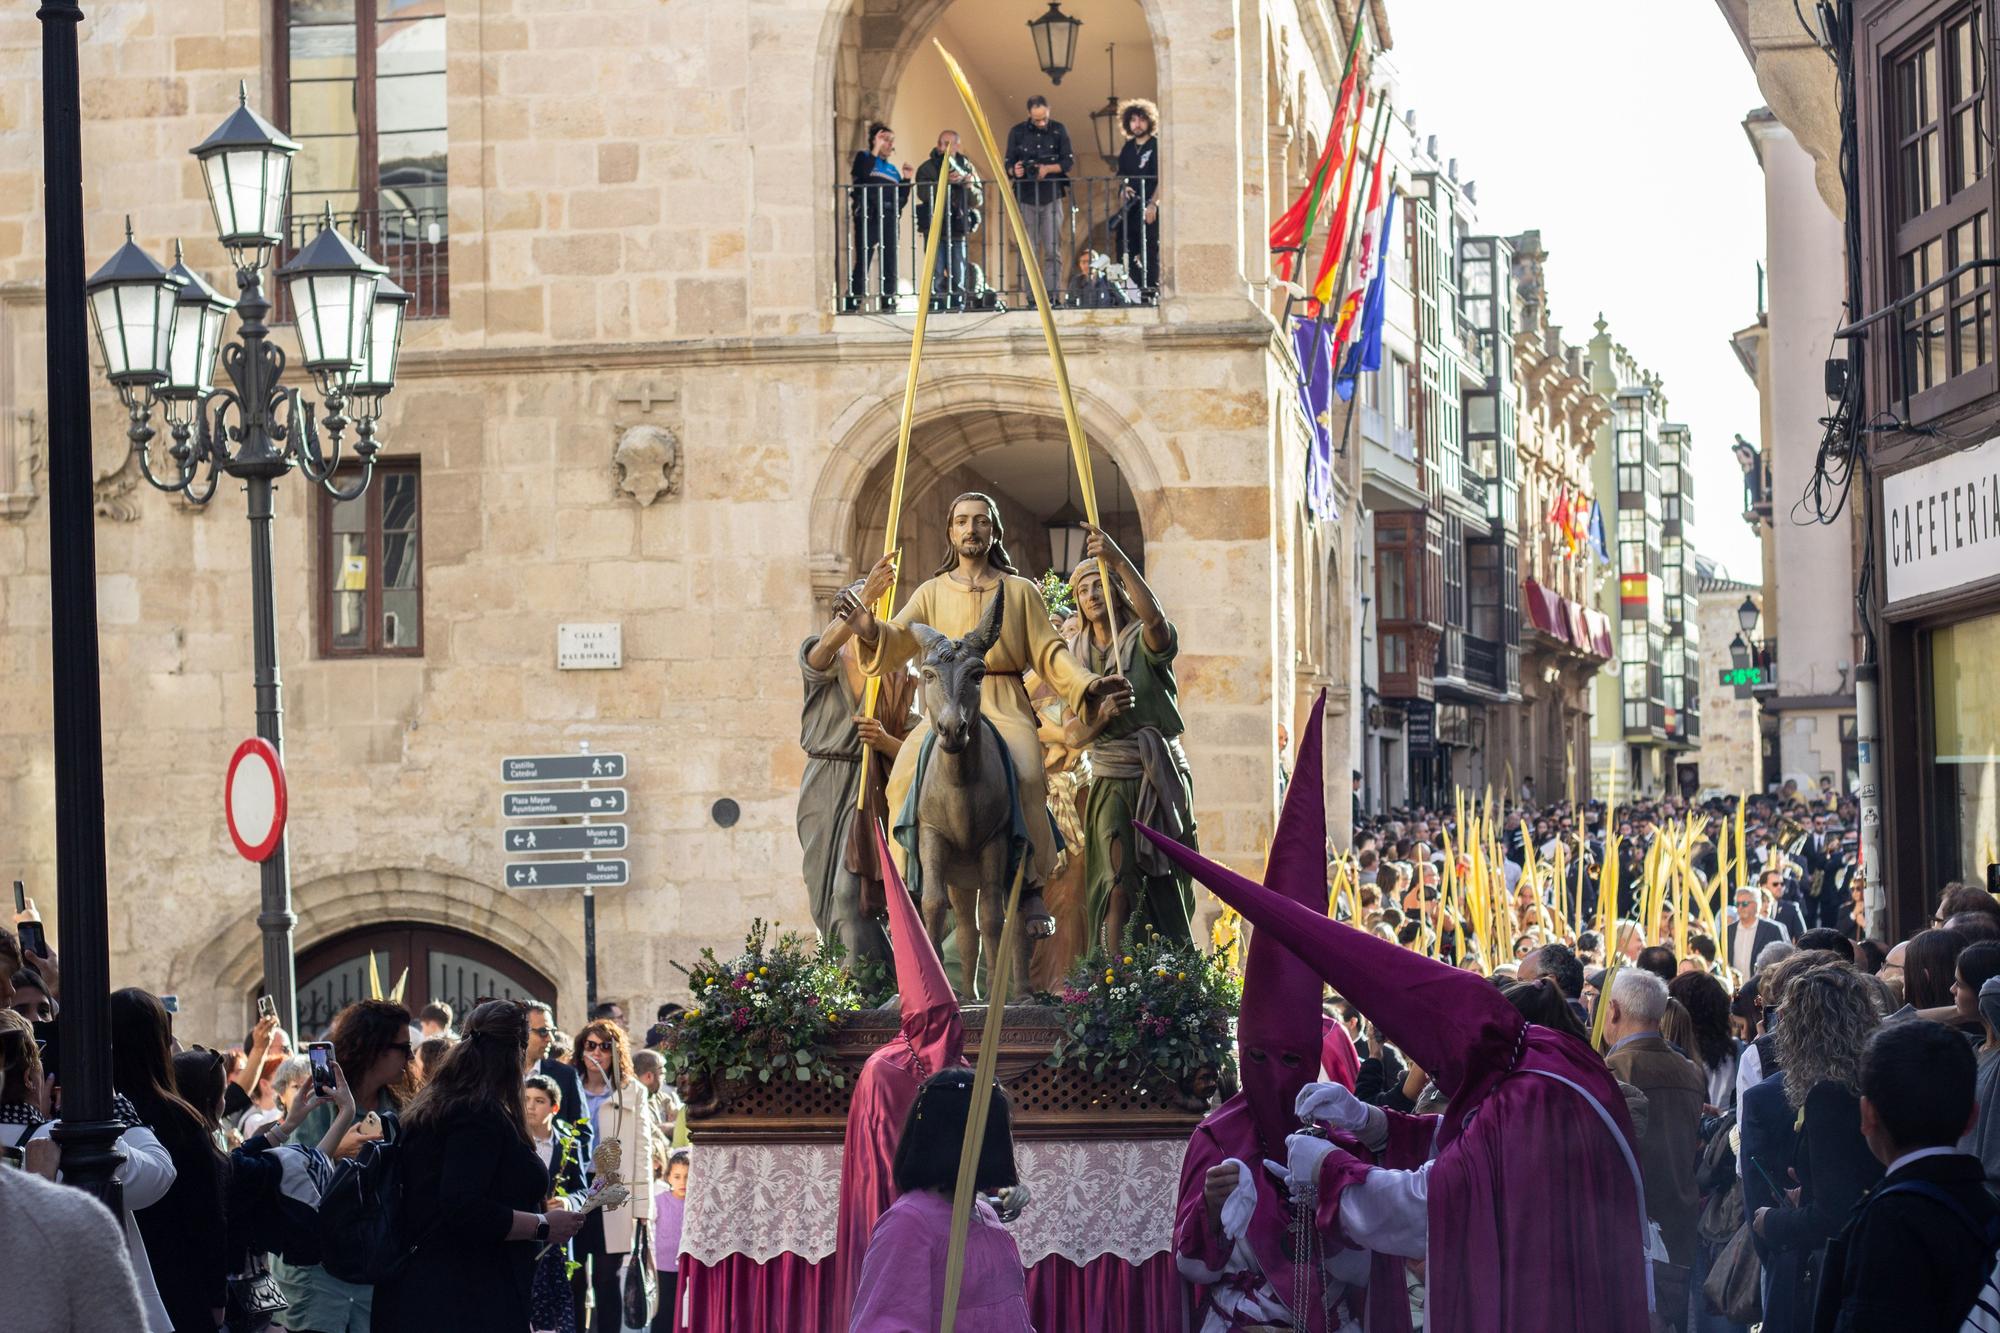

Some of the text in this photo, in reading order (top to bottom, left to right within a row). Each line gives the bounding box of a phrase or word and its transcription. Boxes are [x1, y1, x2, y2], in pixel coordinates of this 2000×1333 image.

[510, 761, 535, 769] Castillo
[510, 769, 538, 777] Catedral
[511, 796, 551, 805] Plaza Mayor
[511, 804, 557, 813] Ayuntamiento
[586, 829, 618, 837] Museo de
[593, 837, 618, 845] Zamora
[596, 864, 618, 872] Museo
[586, 873, 619, 881] Diocesano
